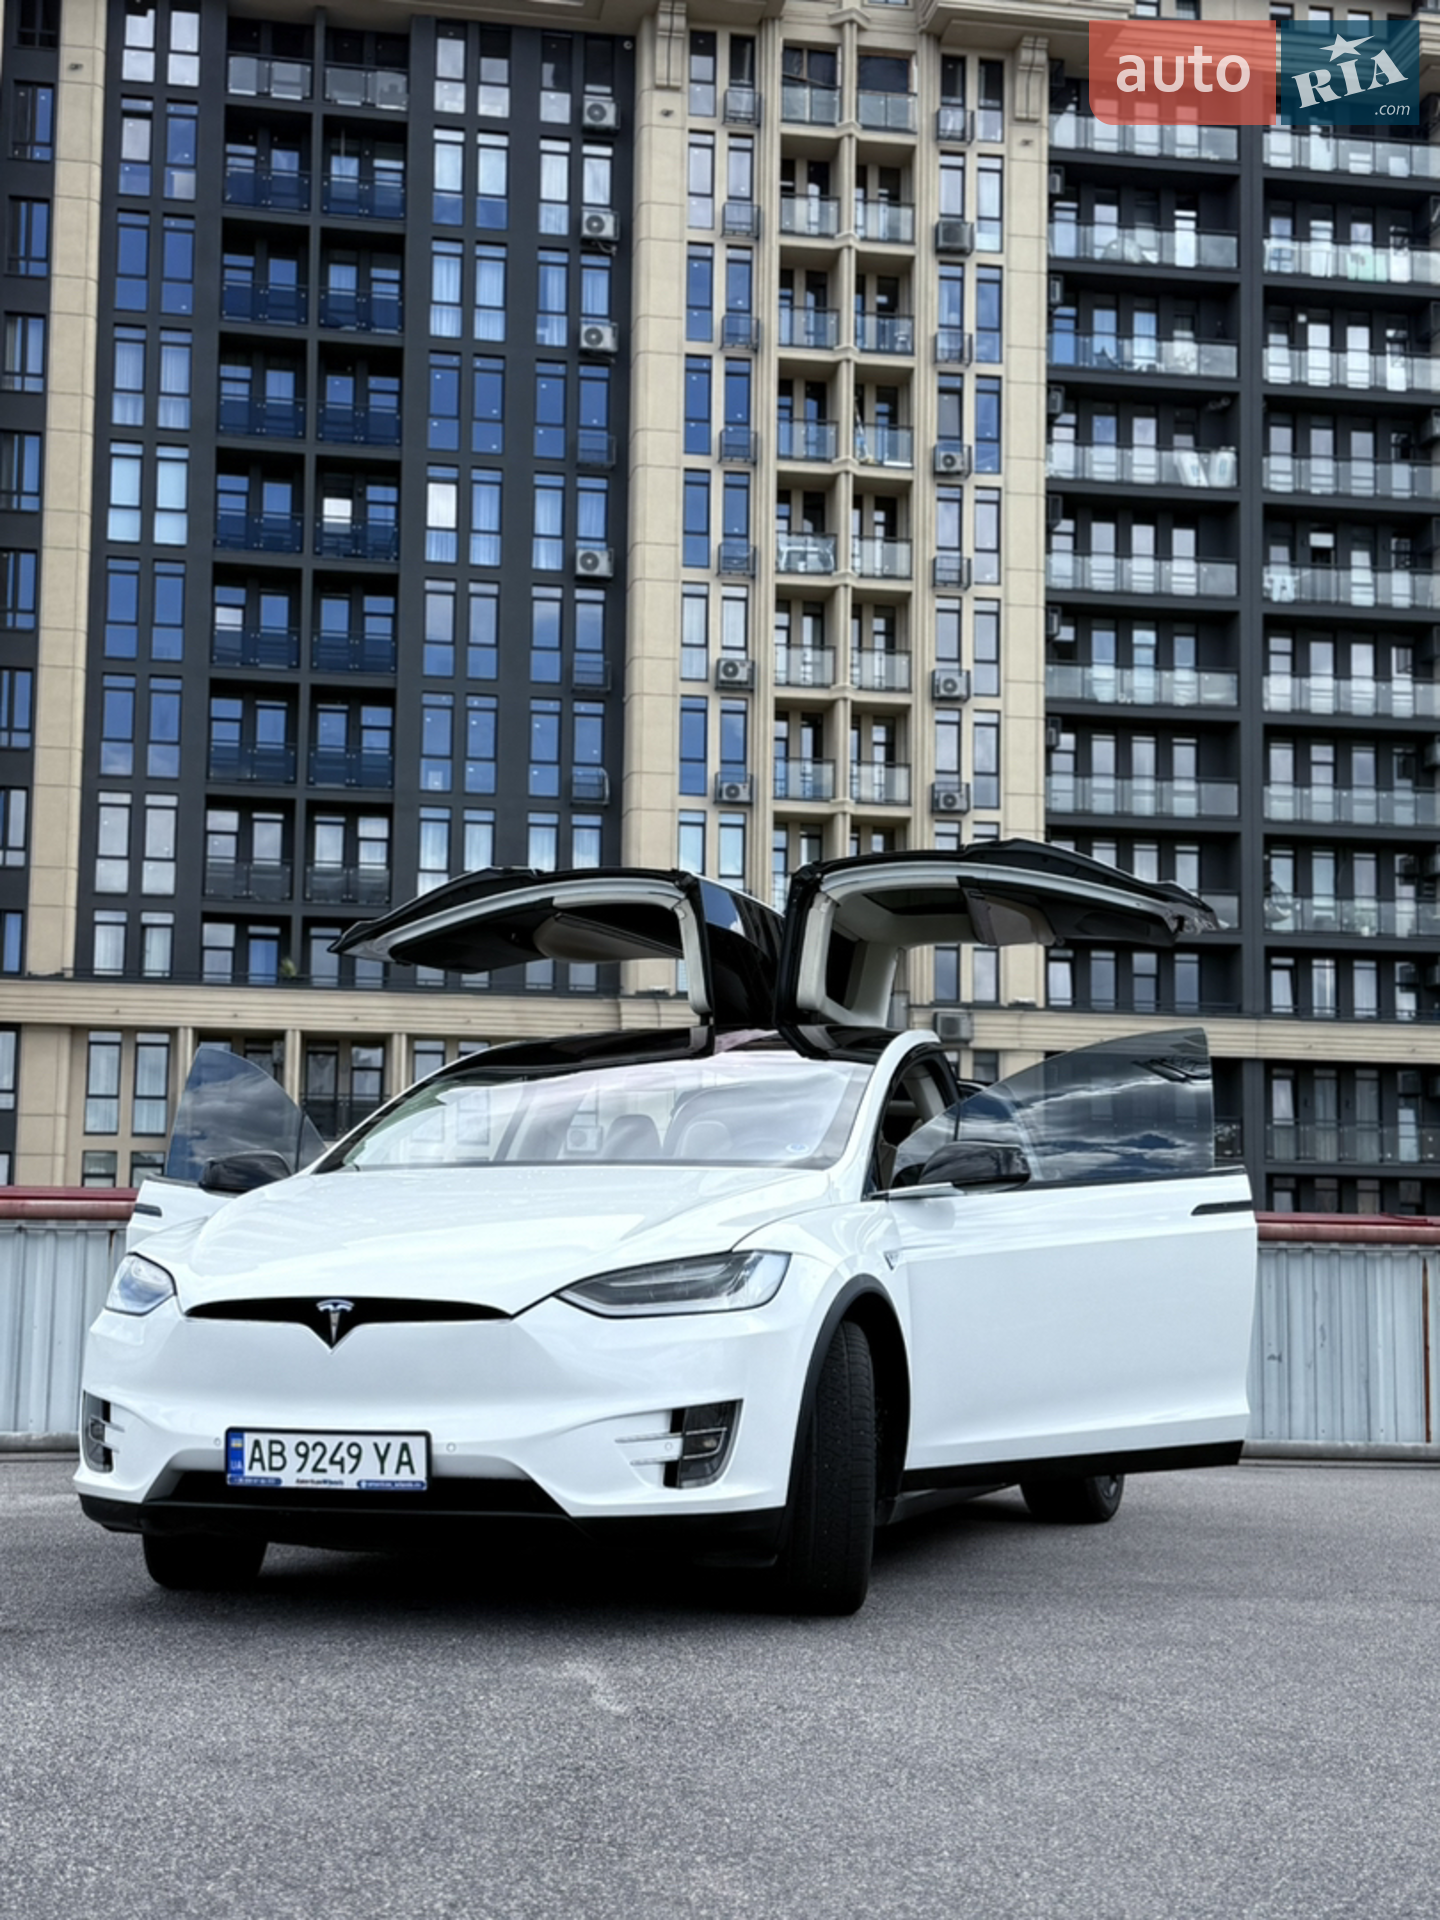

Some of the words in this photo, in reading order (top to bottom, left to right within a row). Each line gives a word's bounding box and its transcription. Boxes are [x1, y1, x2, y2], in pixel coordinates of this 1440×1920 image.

[230, 1460, 243, 1470] UA
[248, 1439, 287, 1472] AB
[294, 1441, 363, 1474] 9249
[372, 1442, 415, 1475] YA
